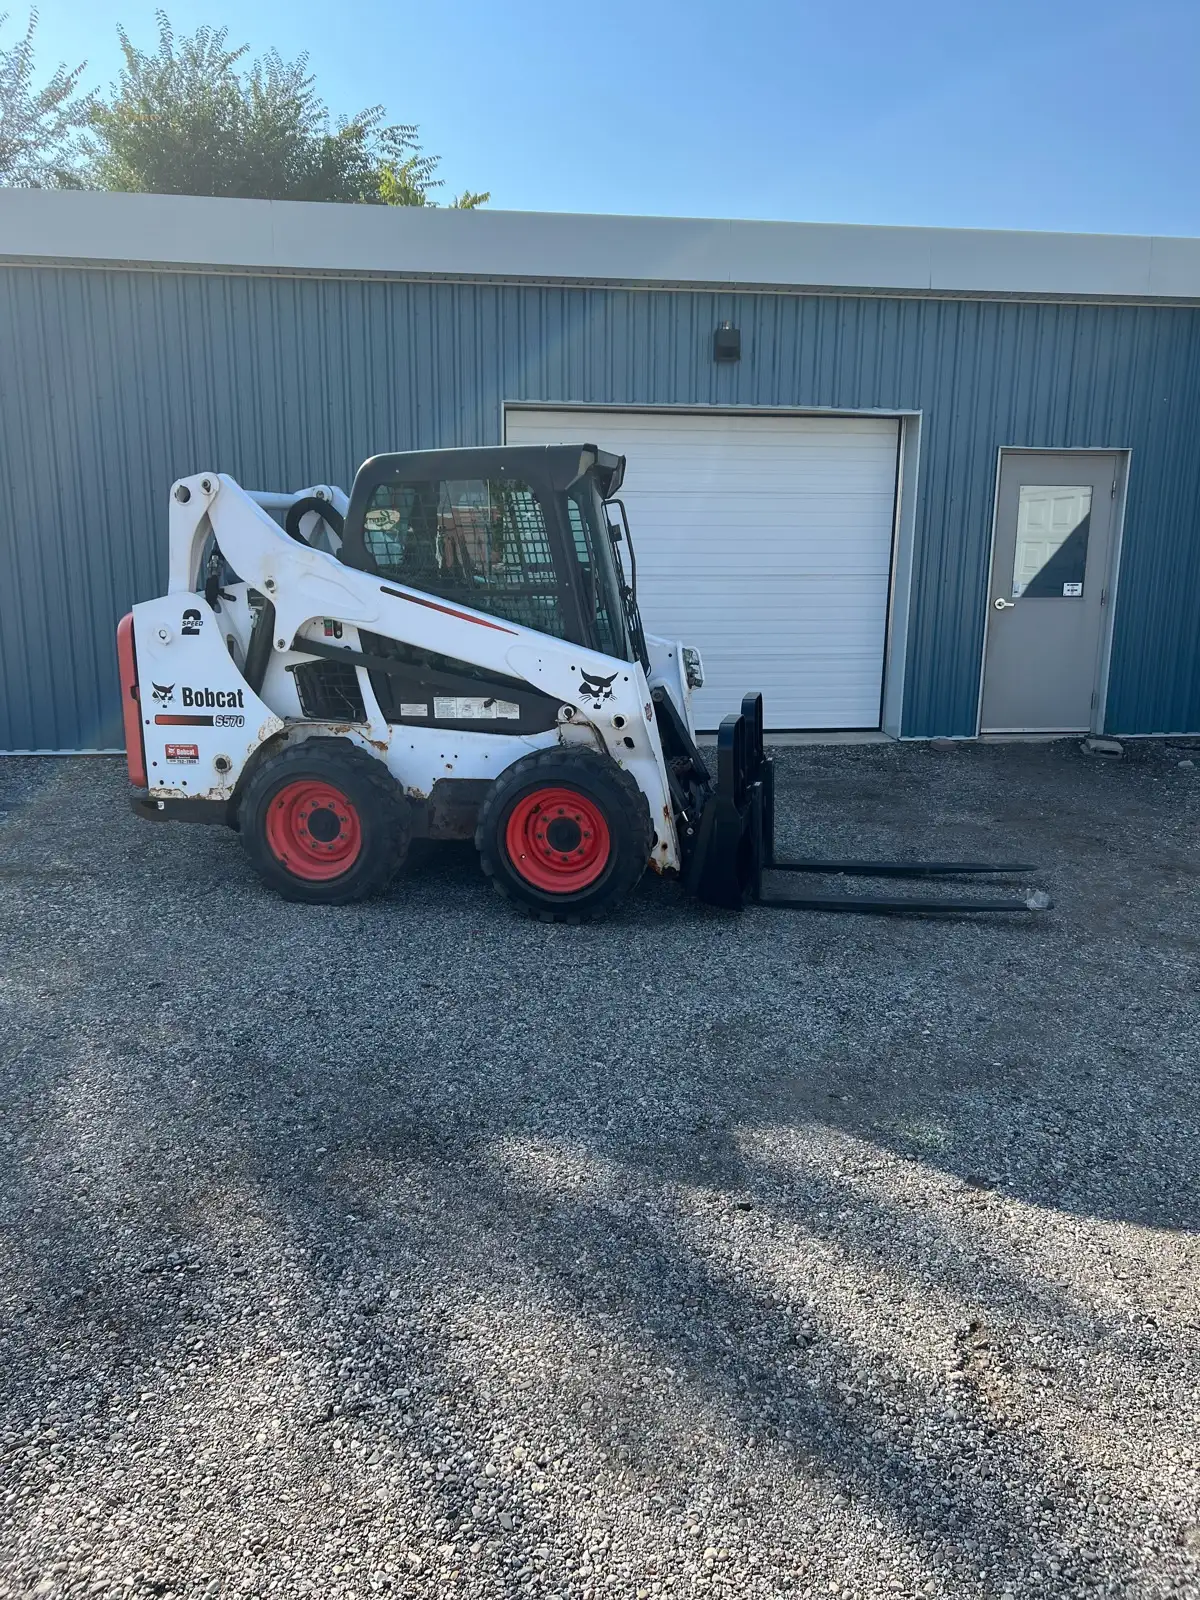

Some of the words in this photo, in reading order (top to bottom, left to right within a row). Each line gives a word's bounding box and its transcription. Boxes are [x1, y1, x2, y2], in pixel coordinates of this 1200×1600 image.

[181, 608, 202, 635] 2
[181, 687, 245, 708] Bobcat
[215, 714, 245, 728] S570
[176, 748, 196, 756] Bobcat
